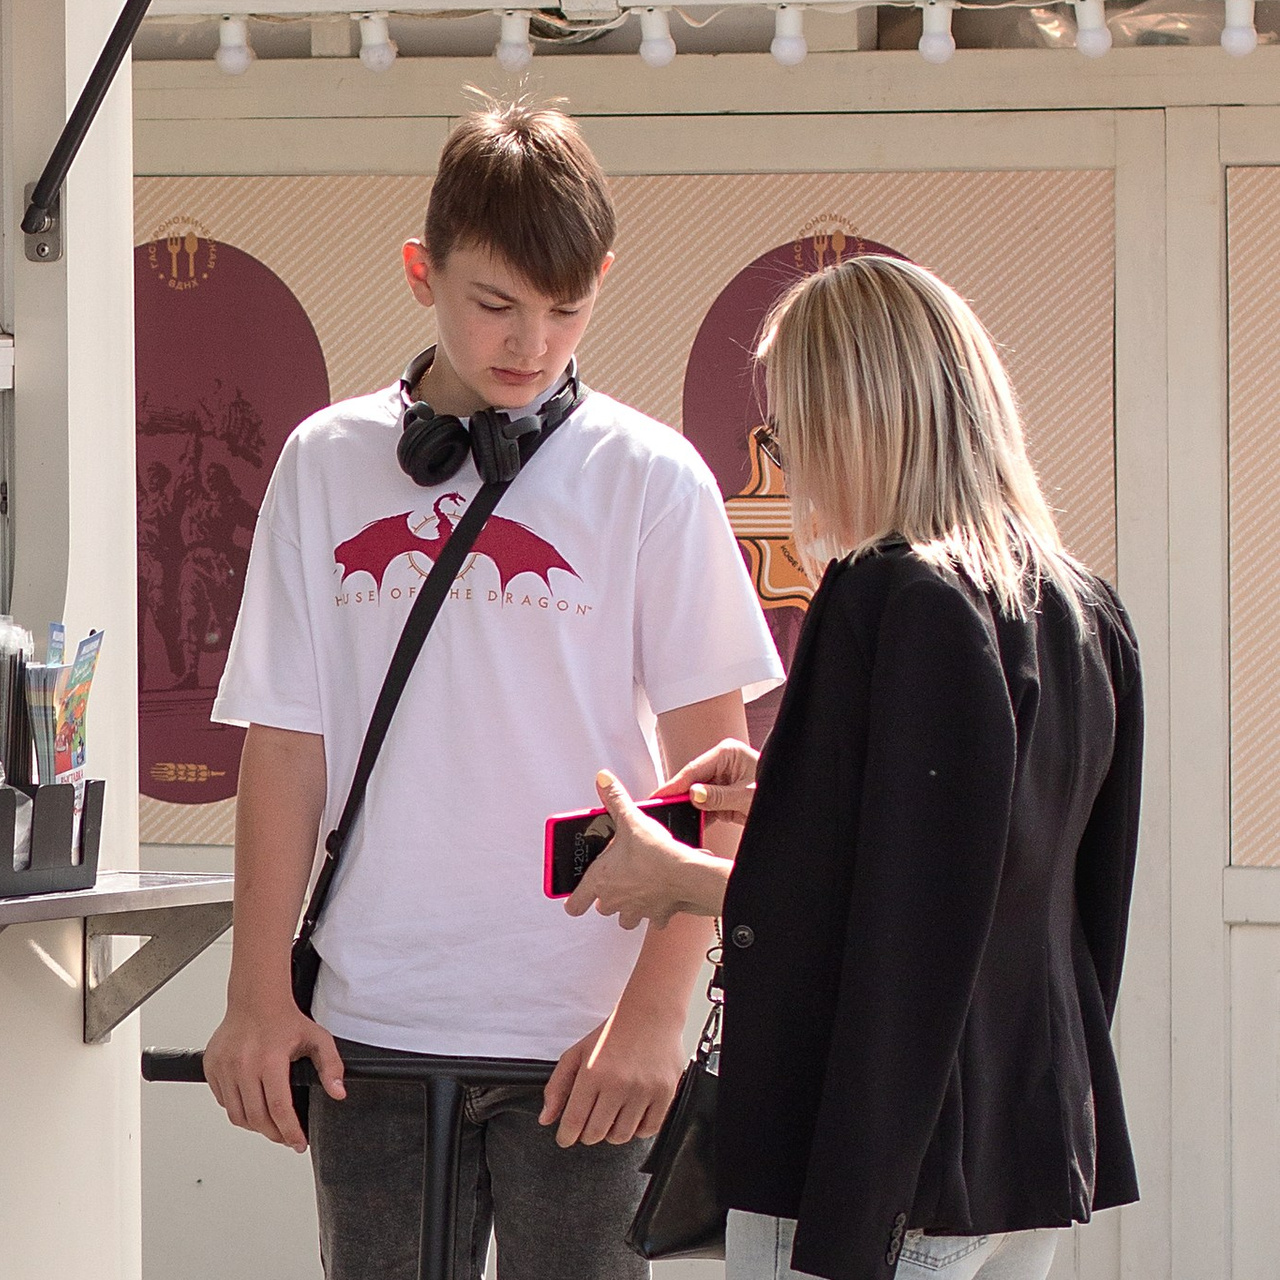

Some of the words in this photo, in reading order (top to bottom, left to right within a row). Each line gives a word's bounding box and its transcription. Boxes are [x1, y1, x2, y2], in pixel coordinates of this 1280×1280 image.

[335, 590, 376, 607] HUSE
[390, 587, 417, 600] OF
[449, 588, 472, 600] HE
